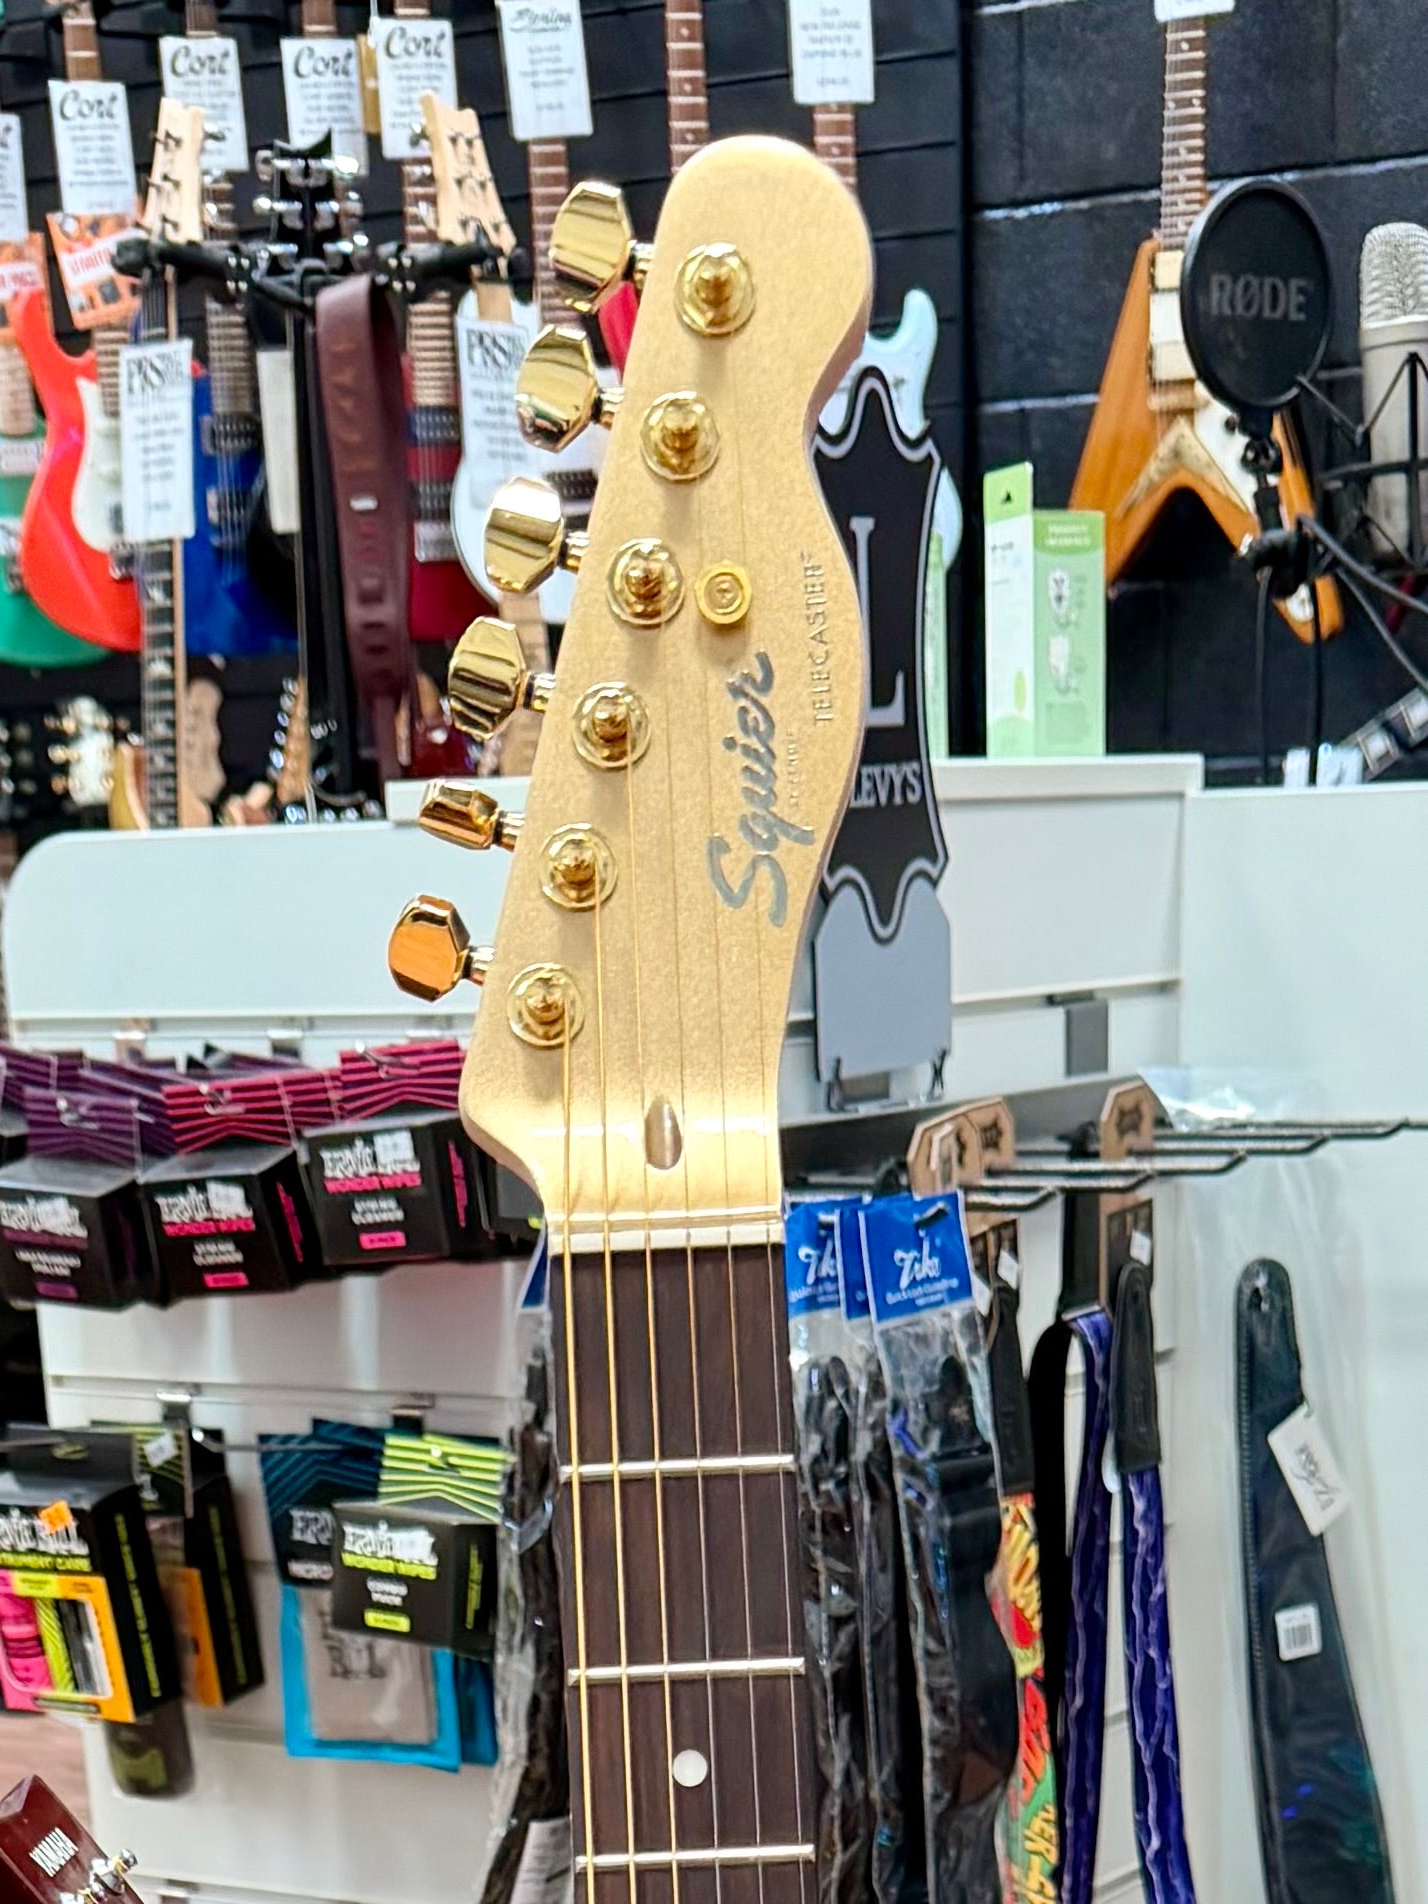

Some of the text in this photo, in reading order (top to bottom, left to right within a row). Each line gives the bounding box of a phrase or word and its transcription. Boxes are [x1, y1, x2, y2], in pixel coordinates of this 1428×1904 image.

[385, 25, 447, 61] Cort
[171, 45, 230, 79] Cort
[292, 46, 355, 80] Cort
[59, 89, 118, 121] Cort
[1209, 272, 1309, 321] RØDE
[706, 648, 815, 930] Squier
[289, 1508, 335, 1546] ERN
[28, 1826, 79, 1879] YAMAHA
